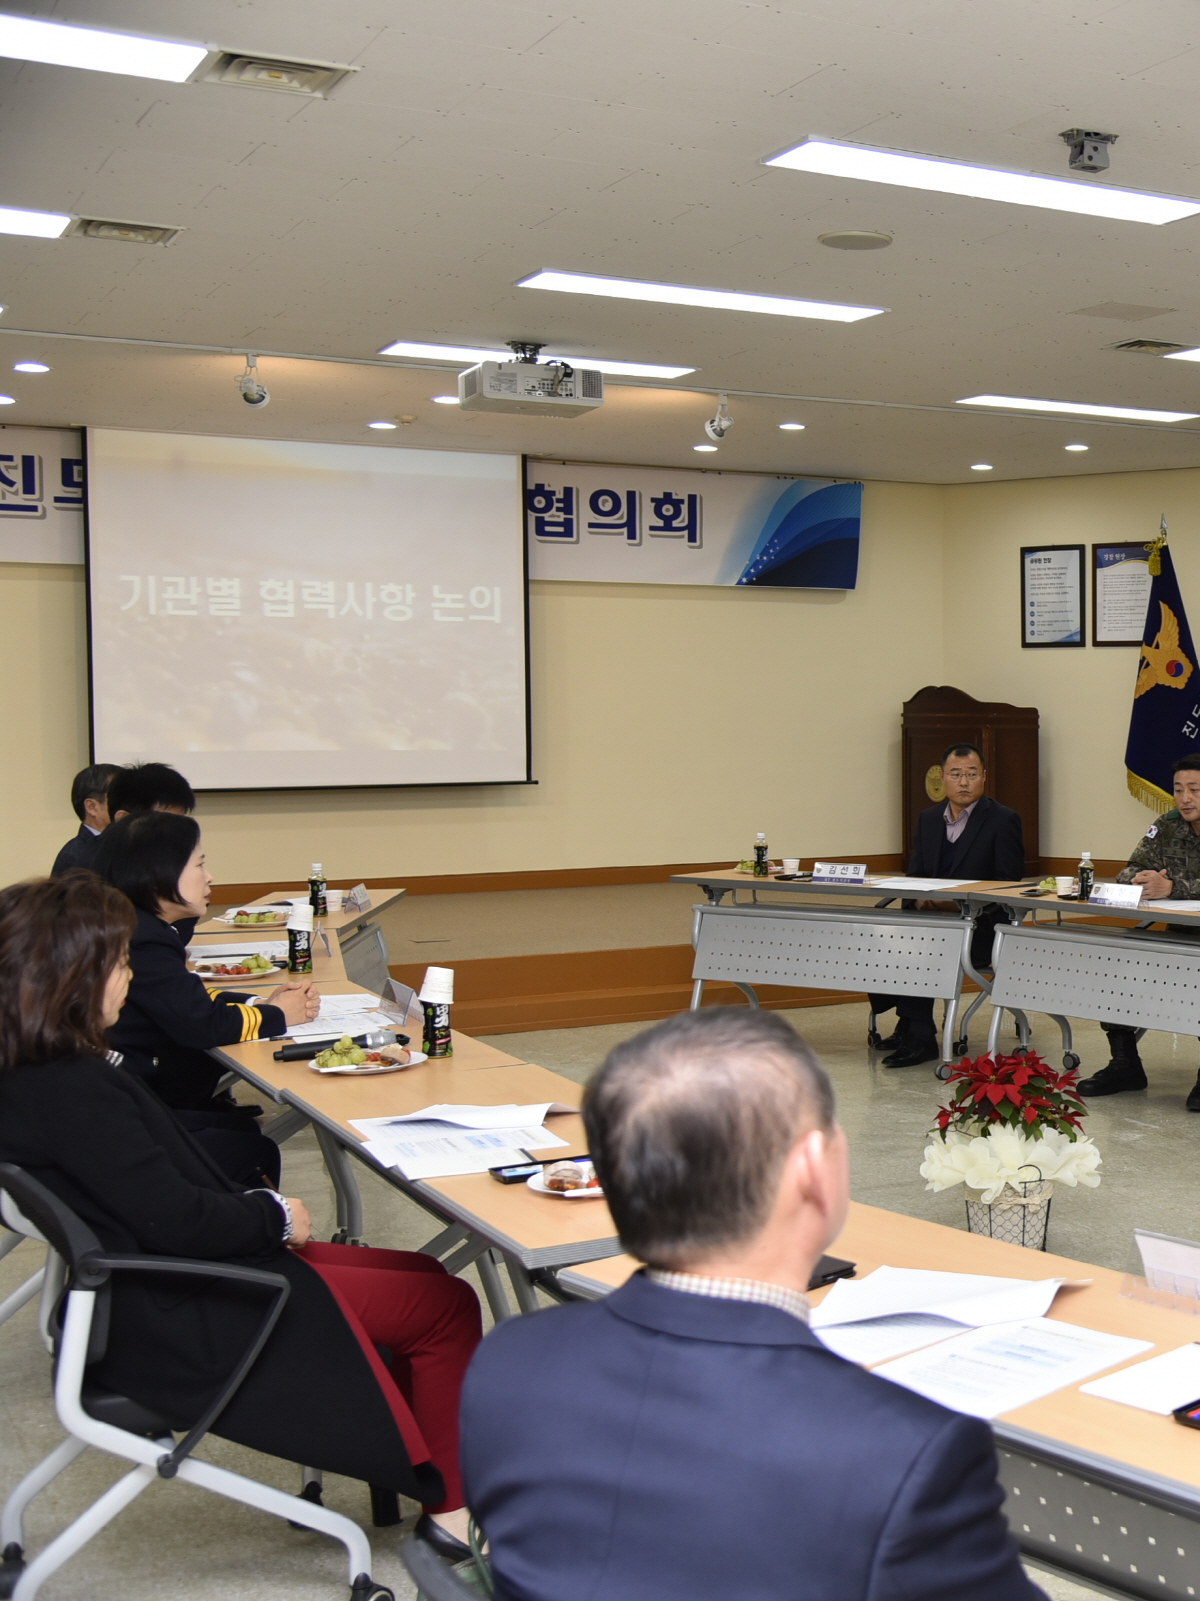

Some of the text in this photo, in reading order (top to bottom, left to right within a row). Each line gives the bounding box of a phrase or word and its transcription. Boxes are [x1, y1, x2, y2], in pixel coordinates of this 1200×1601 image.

[527, 483, 698, 543] 협의회
[119, 575, 501, 623] 기관별 협력사항 논의
